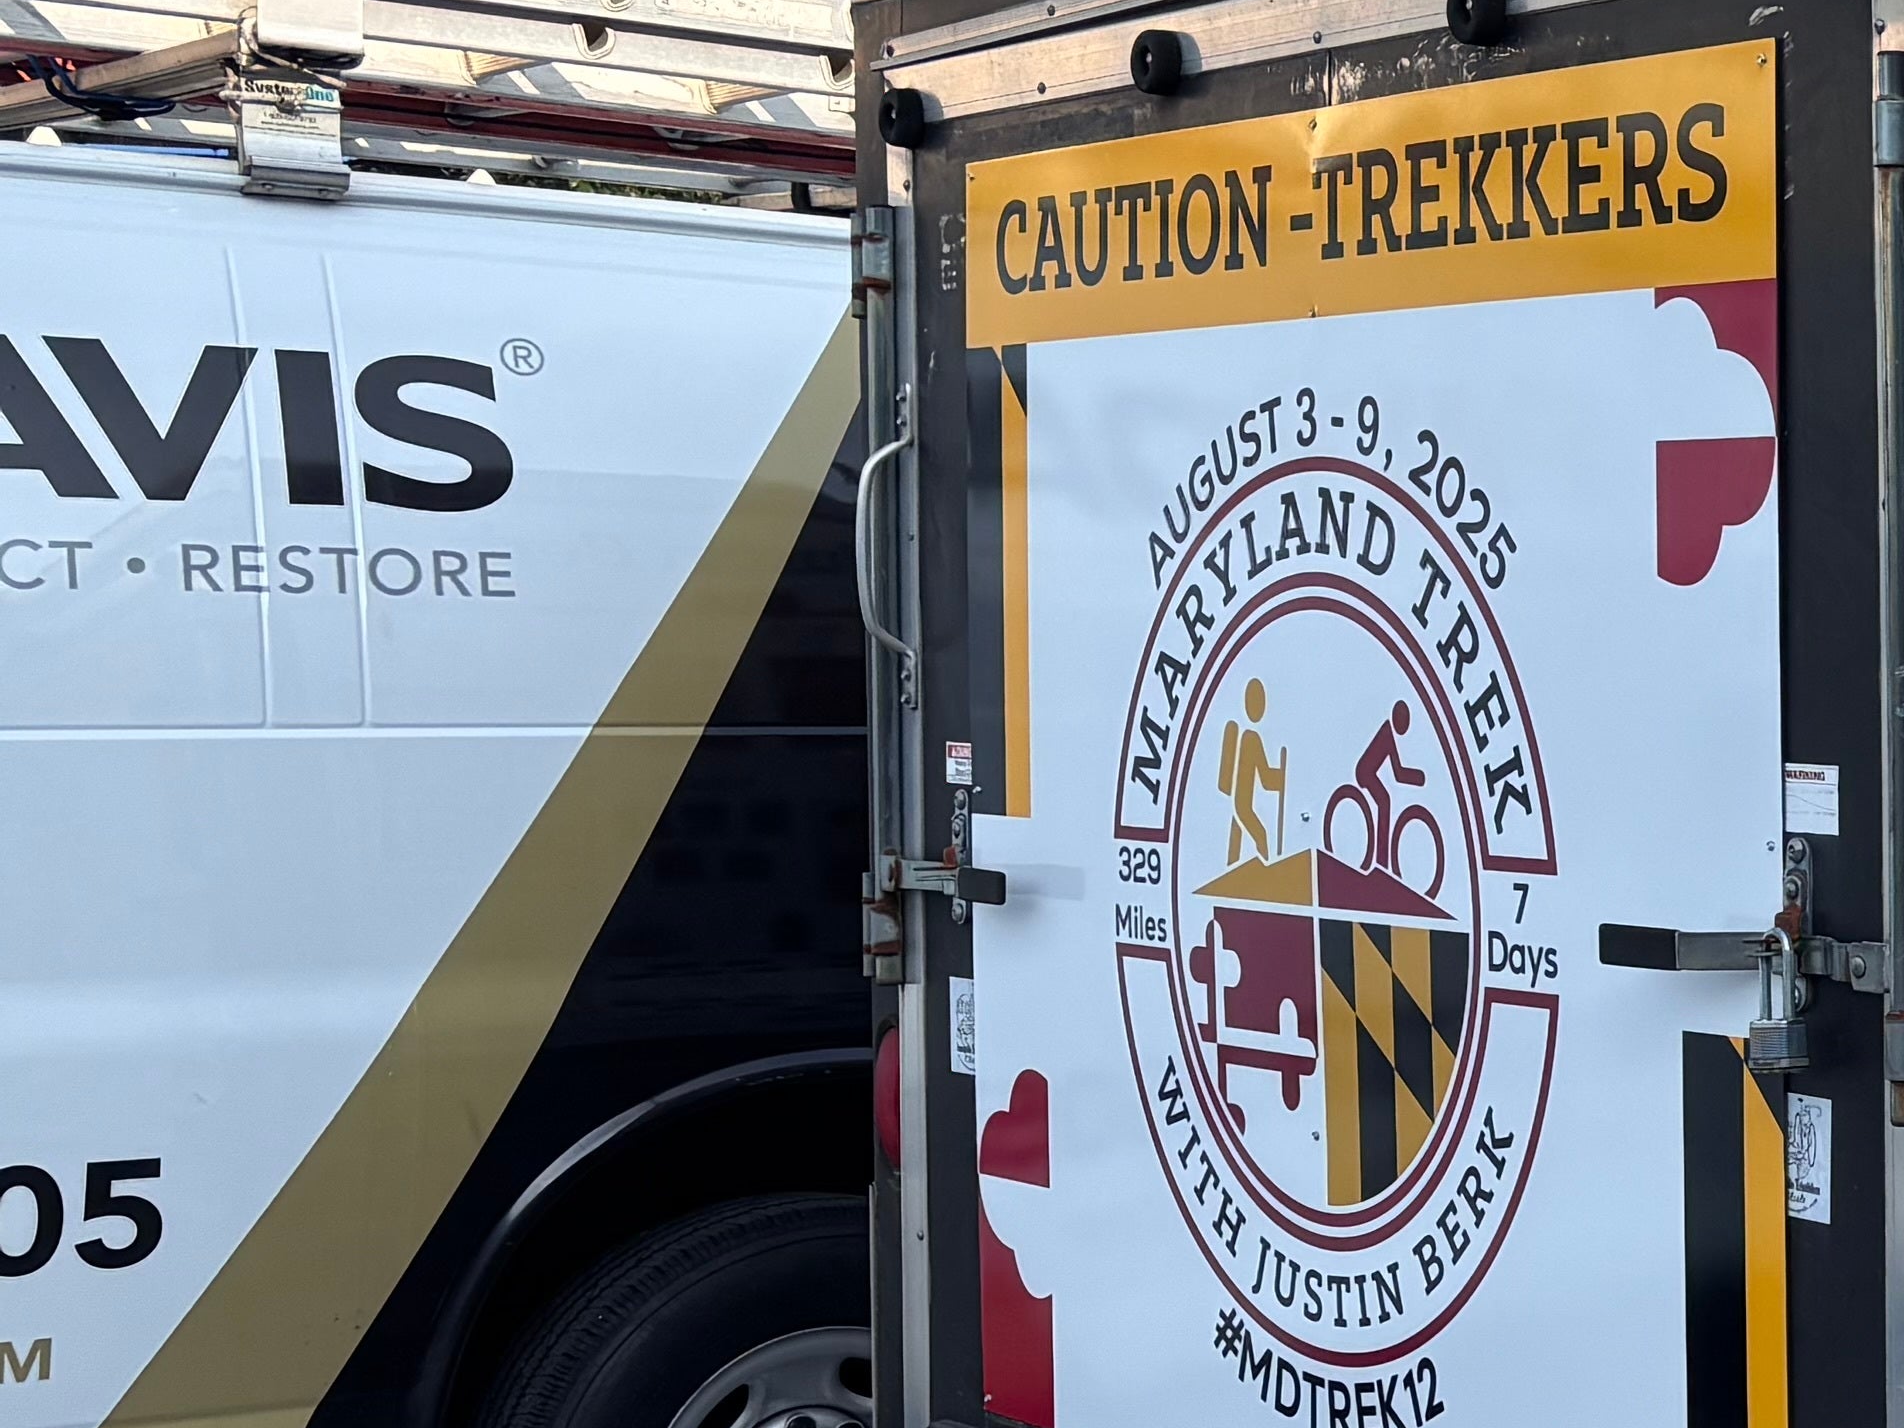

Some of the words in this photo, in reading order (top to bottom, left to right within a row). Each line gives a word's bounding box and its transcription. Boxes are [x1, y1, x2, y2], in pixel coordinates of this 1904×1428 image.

[995, 166, 1271, 294] CAUTION
[1148, 396, 1280, 587] AUGUST
[1412, 429, 1517, 589] 2025
[182, 544, 516, 597] RESTORE
[1130, 485, 1396, 804] MARYLAND
[1420, 558, 1531, 835] TREK
[1117, 847, 1162, 884] 329
[1513, 883, 1527, 924] 7
[1115, 903, 1167, 942] Miles
[1488, 931, 1559, 979] Days
[0, 1158, 162, 1277] 05
[1156, 1057, 1246, 1258] WITH
[1252, 1250, 1406, 1328] JUSTIN
[1420, 1106, 1516, 1297] BERK
